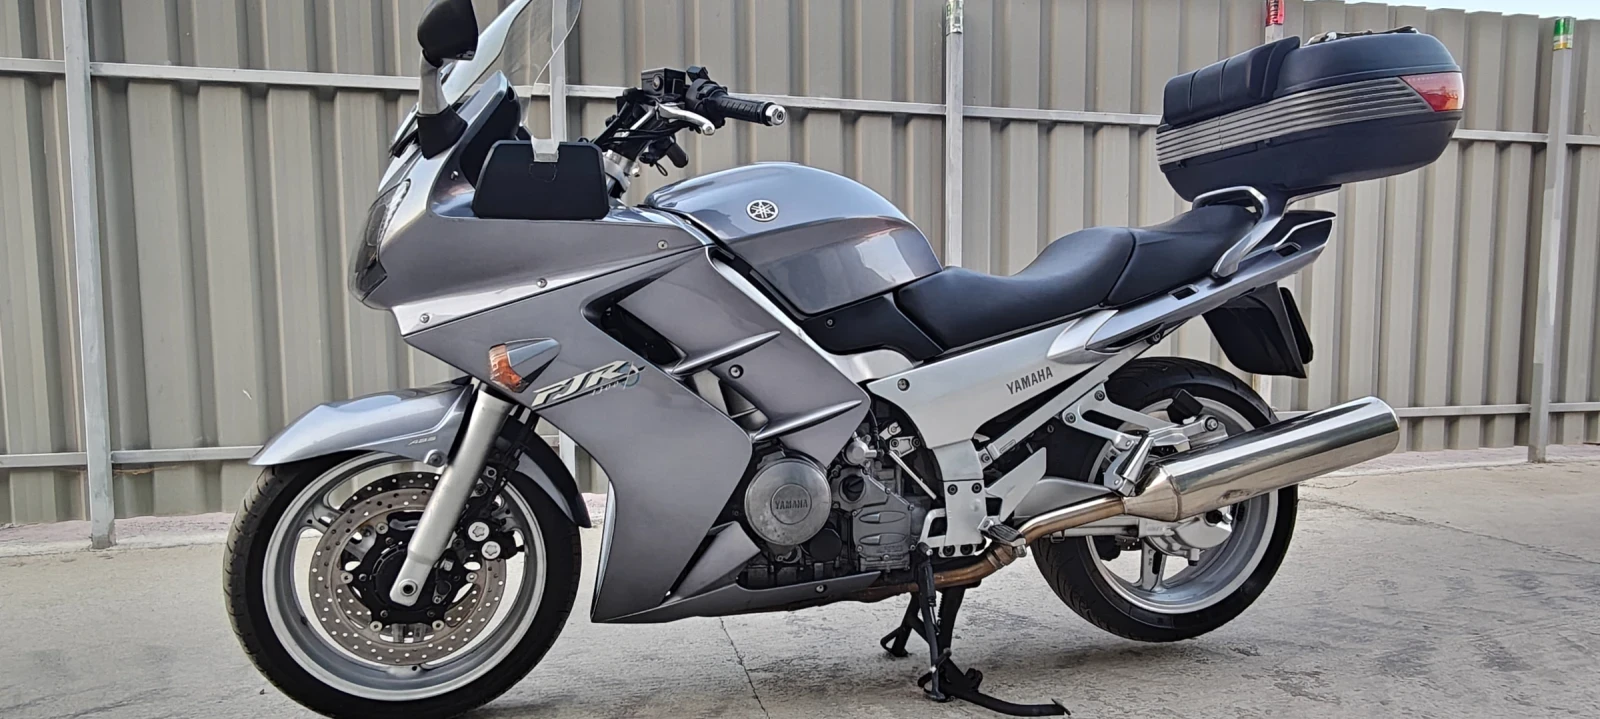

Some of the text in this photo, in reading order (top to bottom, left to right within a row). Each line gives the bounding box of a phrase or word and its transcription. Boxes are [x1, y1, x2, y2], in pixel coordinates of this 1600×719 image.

[531, 360, 629, 407] FJR
[1006, 366, 1054, 395] YAMAHA
[408, 436, 437, 446] ABS
[775, 499, 808, 510] YAMAHA
